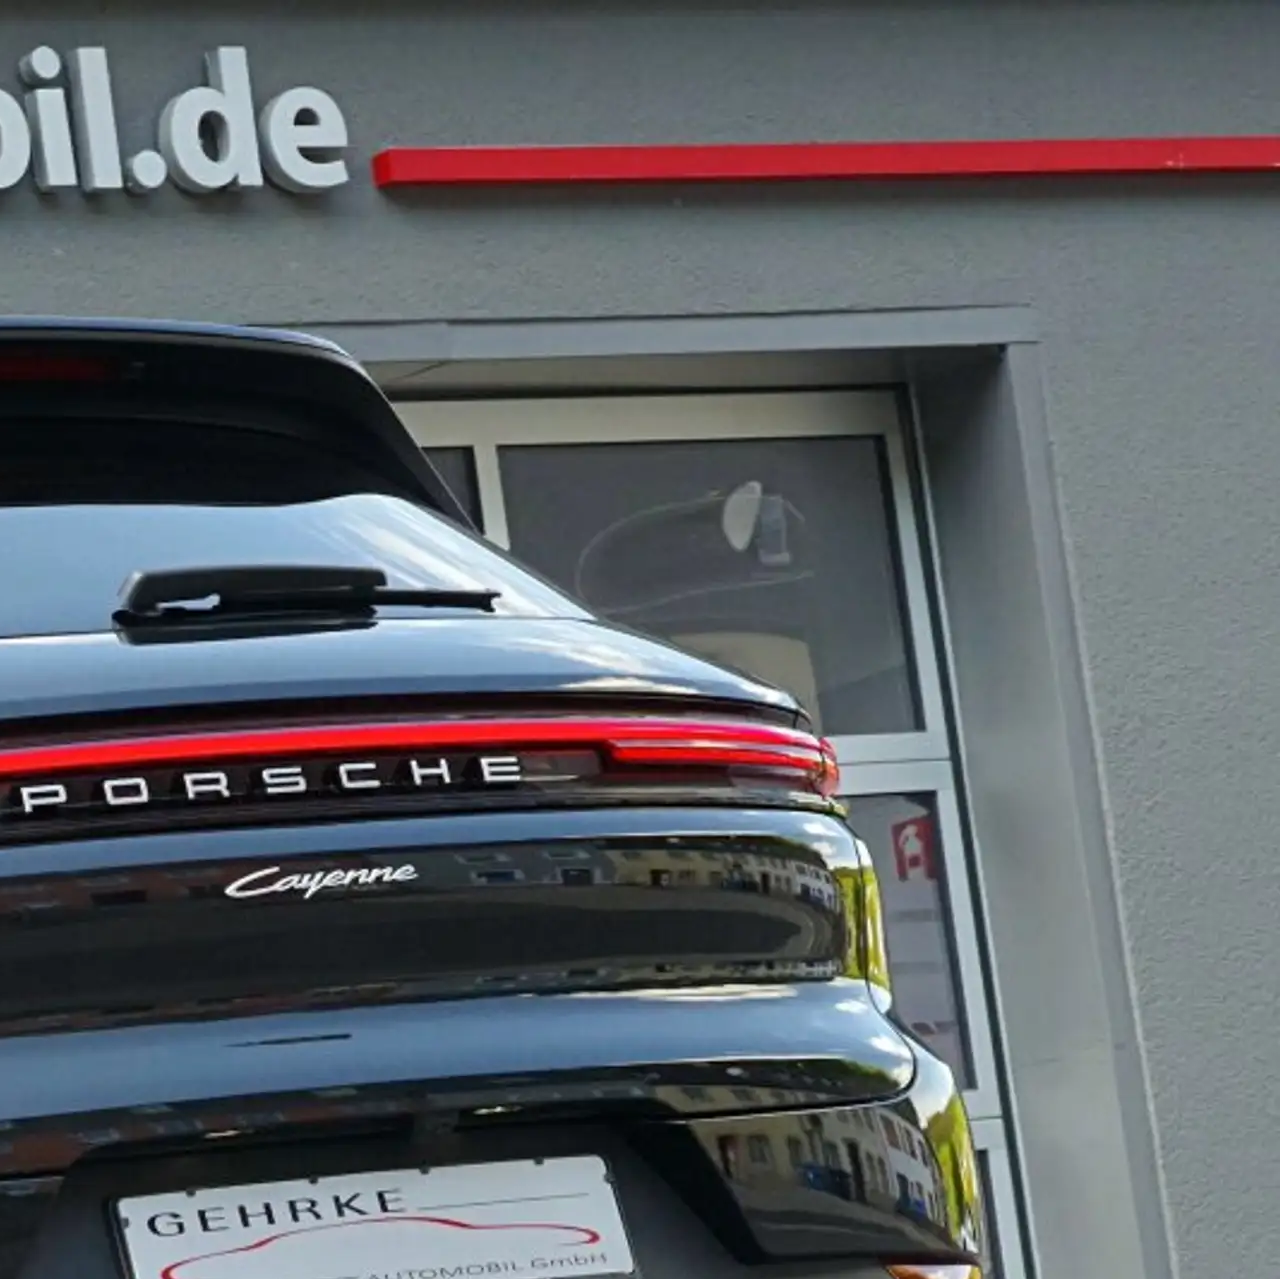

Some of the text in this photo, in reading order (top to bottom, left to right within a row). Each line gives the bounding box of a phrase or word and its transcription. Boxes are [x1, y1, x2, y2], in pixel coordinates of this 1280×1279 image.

[21, 756, 522, 813] PORSCHE
[225, 862, 419, 899] Cayenne
[147, 1188, 407, 1238] GEHRKE
[530, 1252, 608, 1269] GmbH
